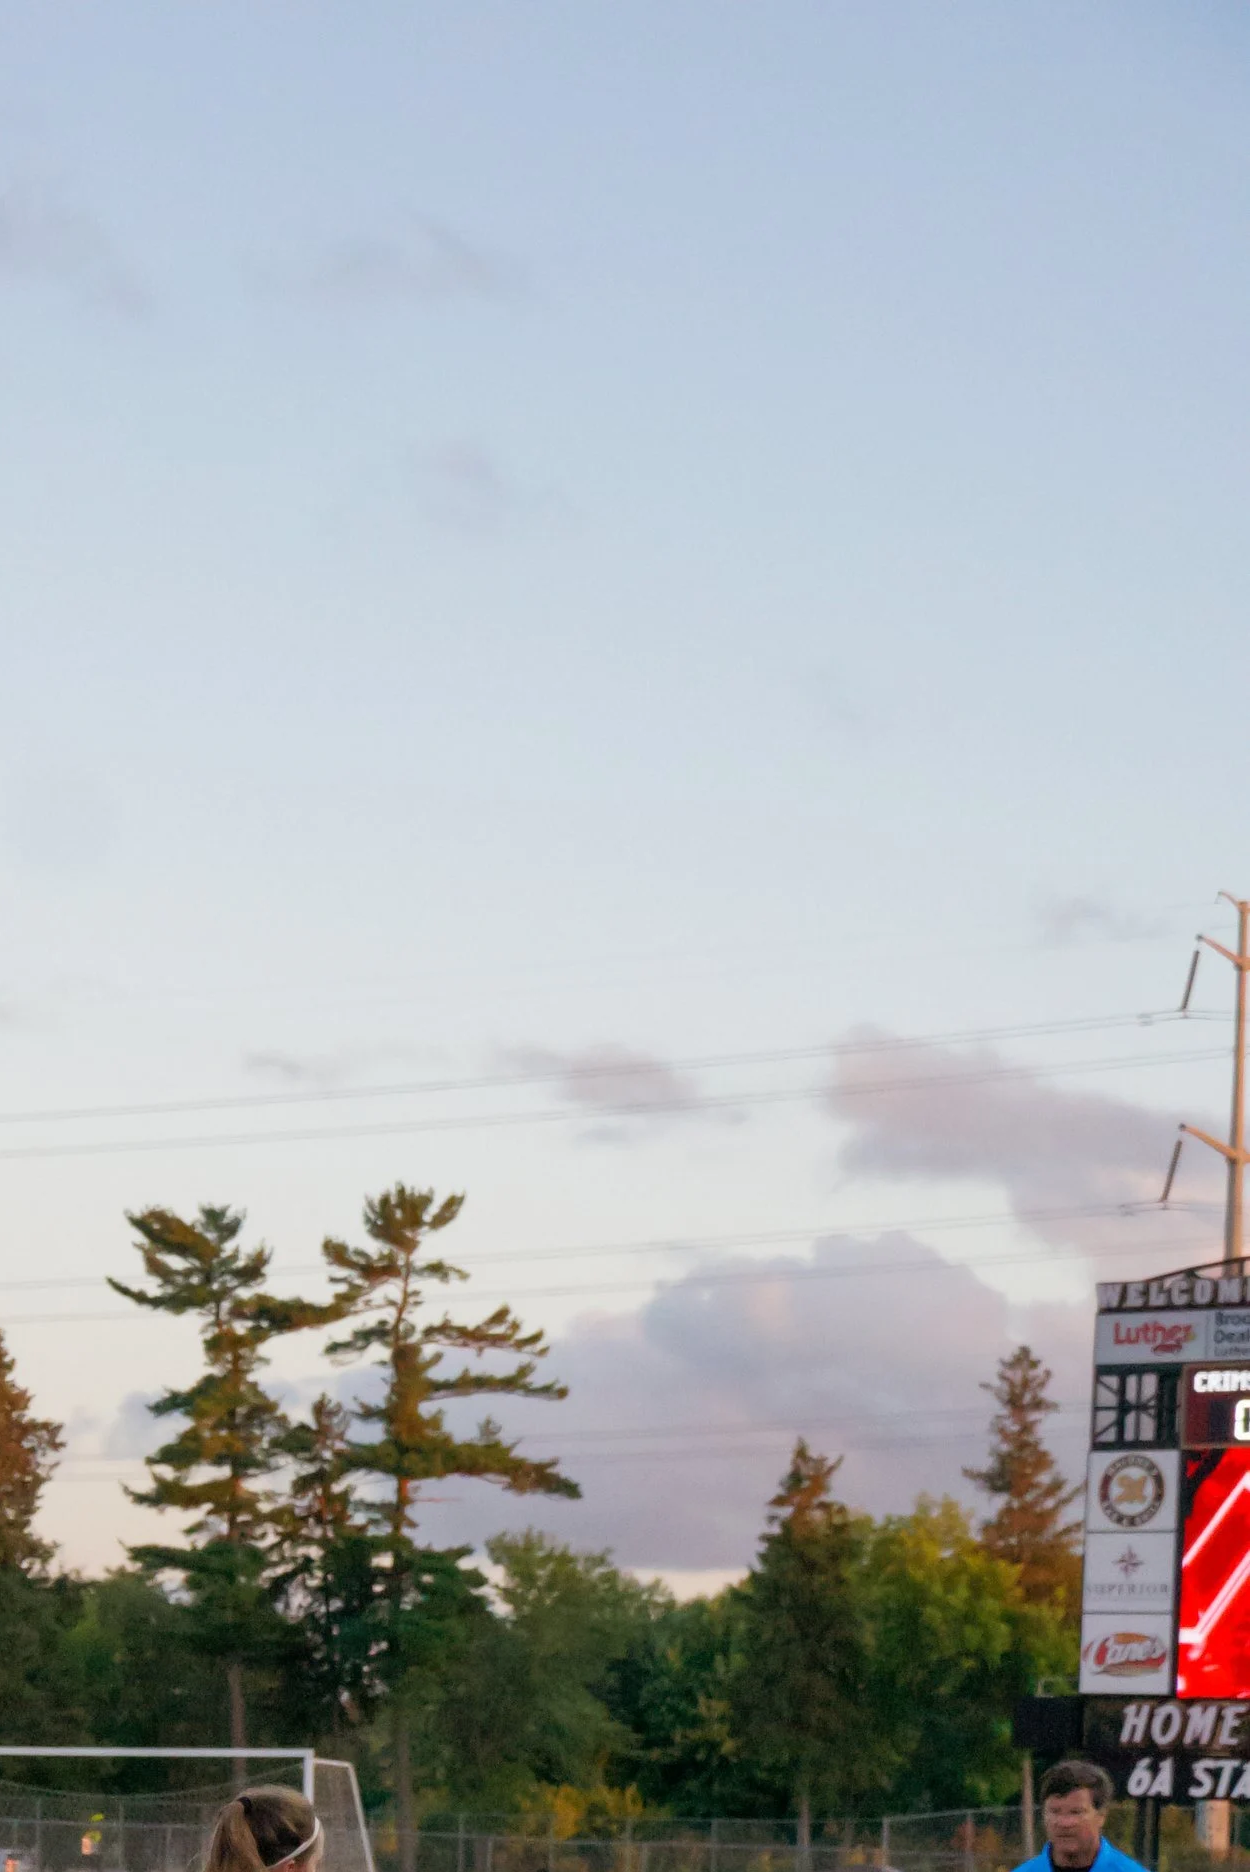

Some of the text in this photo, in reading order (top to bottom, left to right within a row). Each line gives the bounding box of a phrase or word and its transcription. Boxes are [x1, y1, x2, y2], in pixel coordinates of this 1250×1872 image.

[1096, 1277, 1250, 1309] WELCOM
[1113, 1321, 1192, 1345] Luther
[1119, 1704, 1248, 1745] HOME
[1127, 1757, 1174, 1797] 6A
